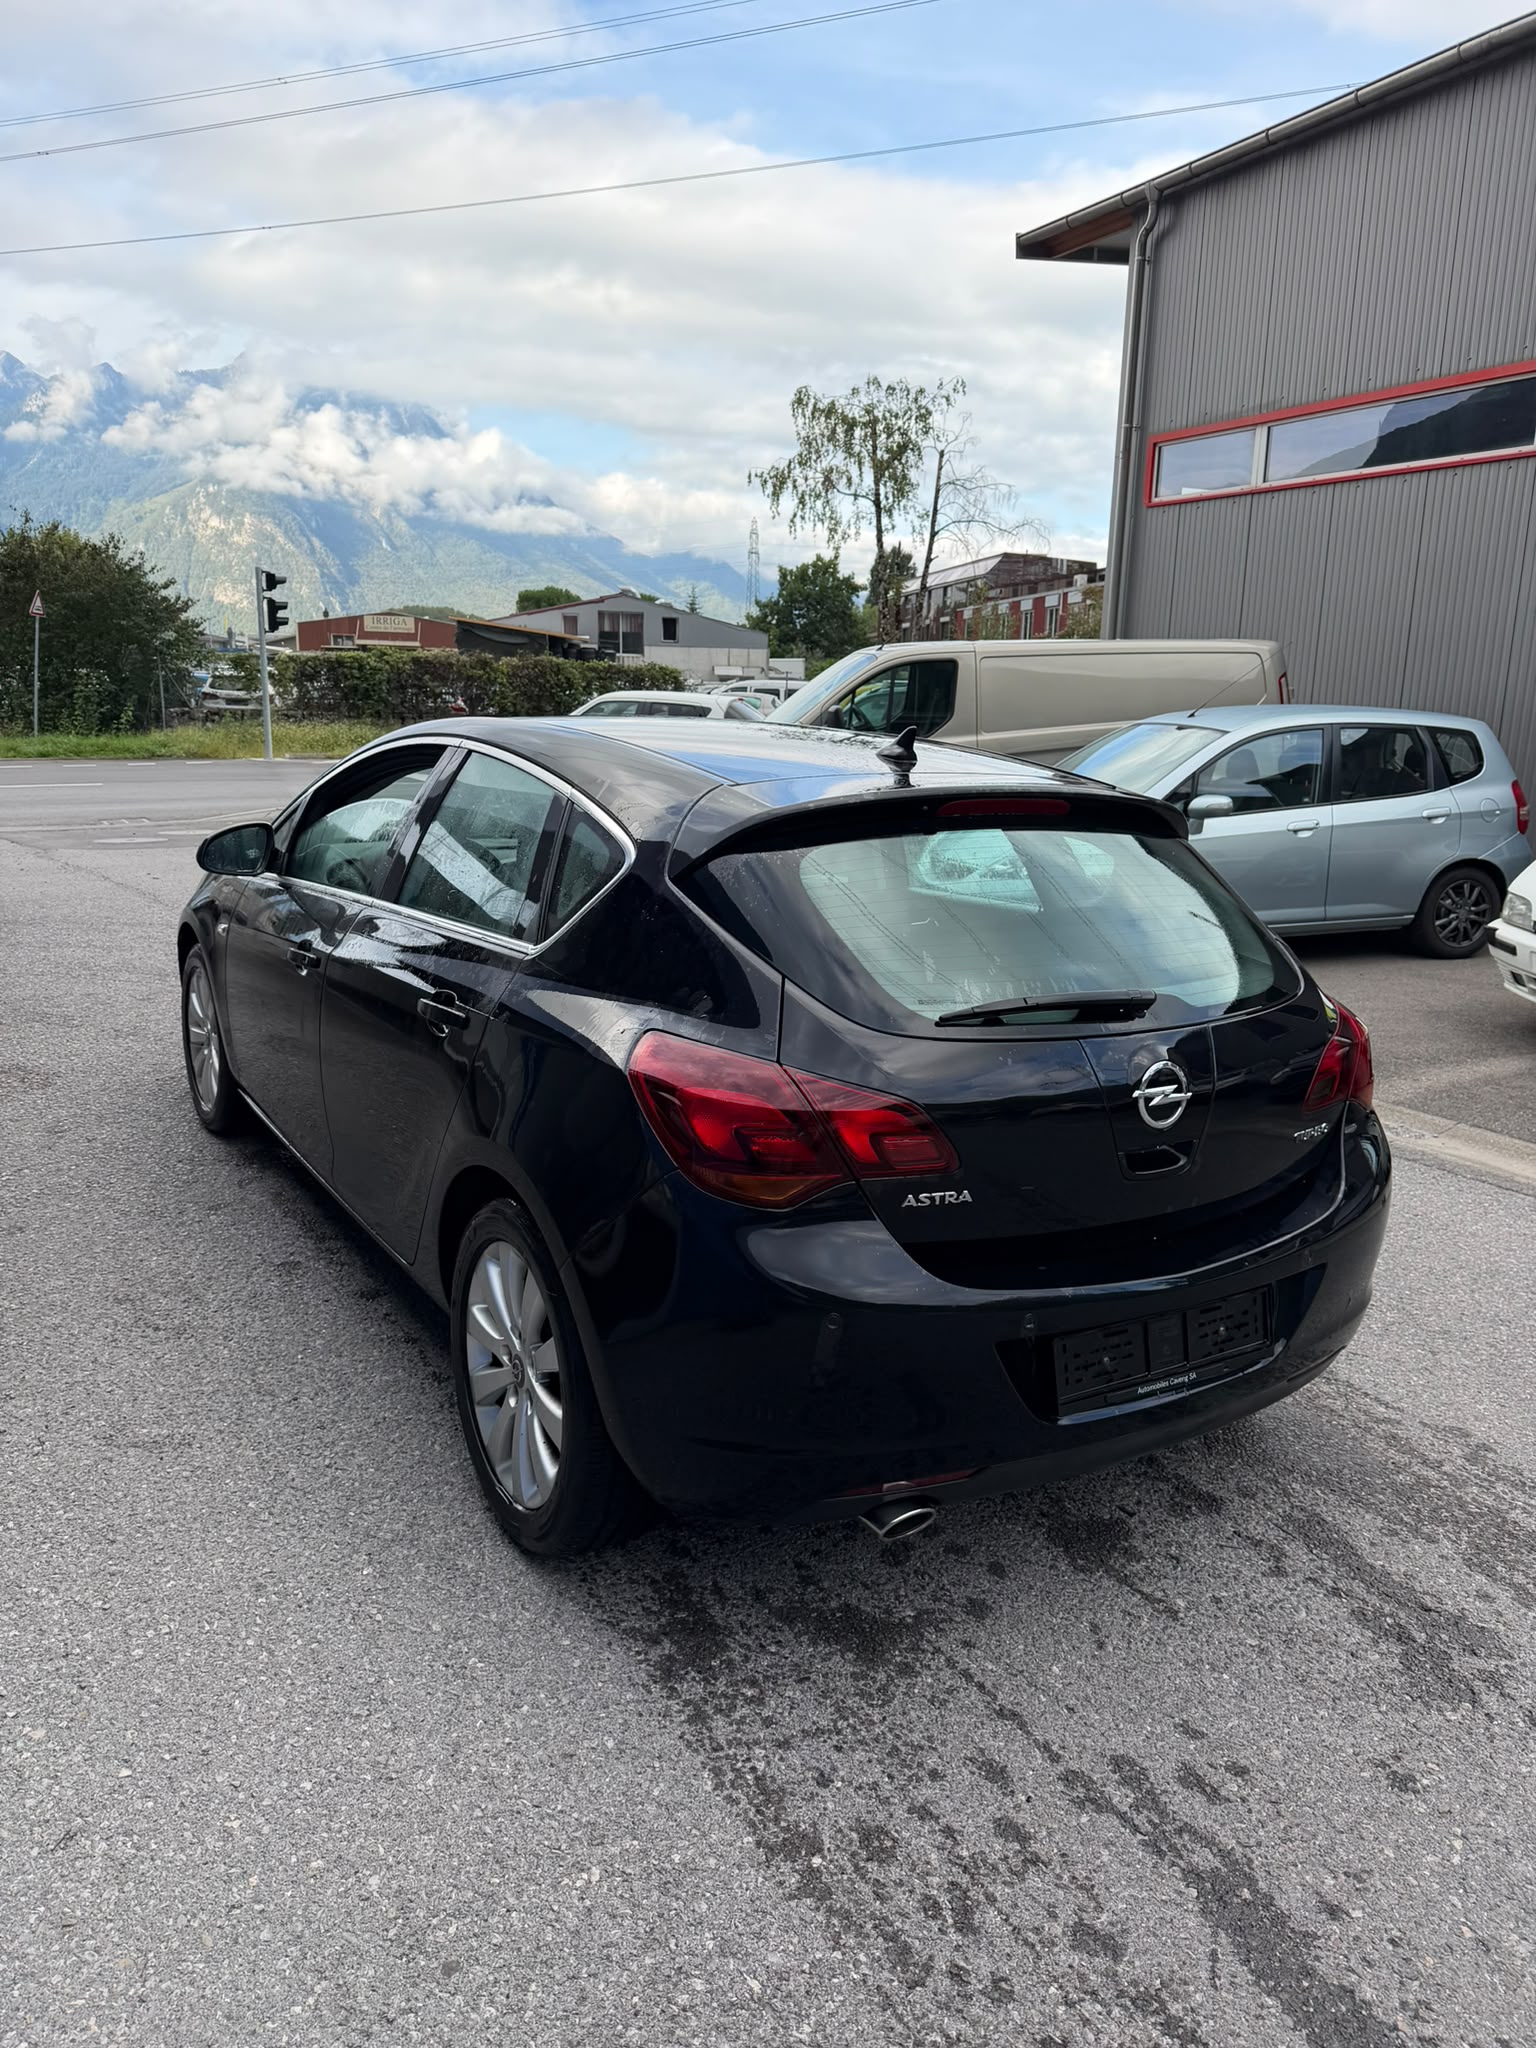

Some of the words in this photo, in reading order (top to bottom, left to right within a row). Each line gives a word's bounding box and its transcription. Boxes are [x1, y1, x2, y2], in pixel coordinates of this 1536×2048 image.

[371, 616, 408, 626] IRRIGA
[901, 1189, 973, 1207] ASTRA
[1137, 1380, 1169, 1395] Automobiles
[1189, 1371, 1197, 1381] SA
